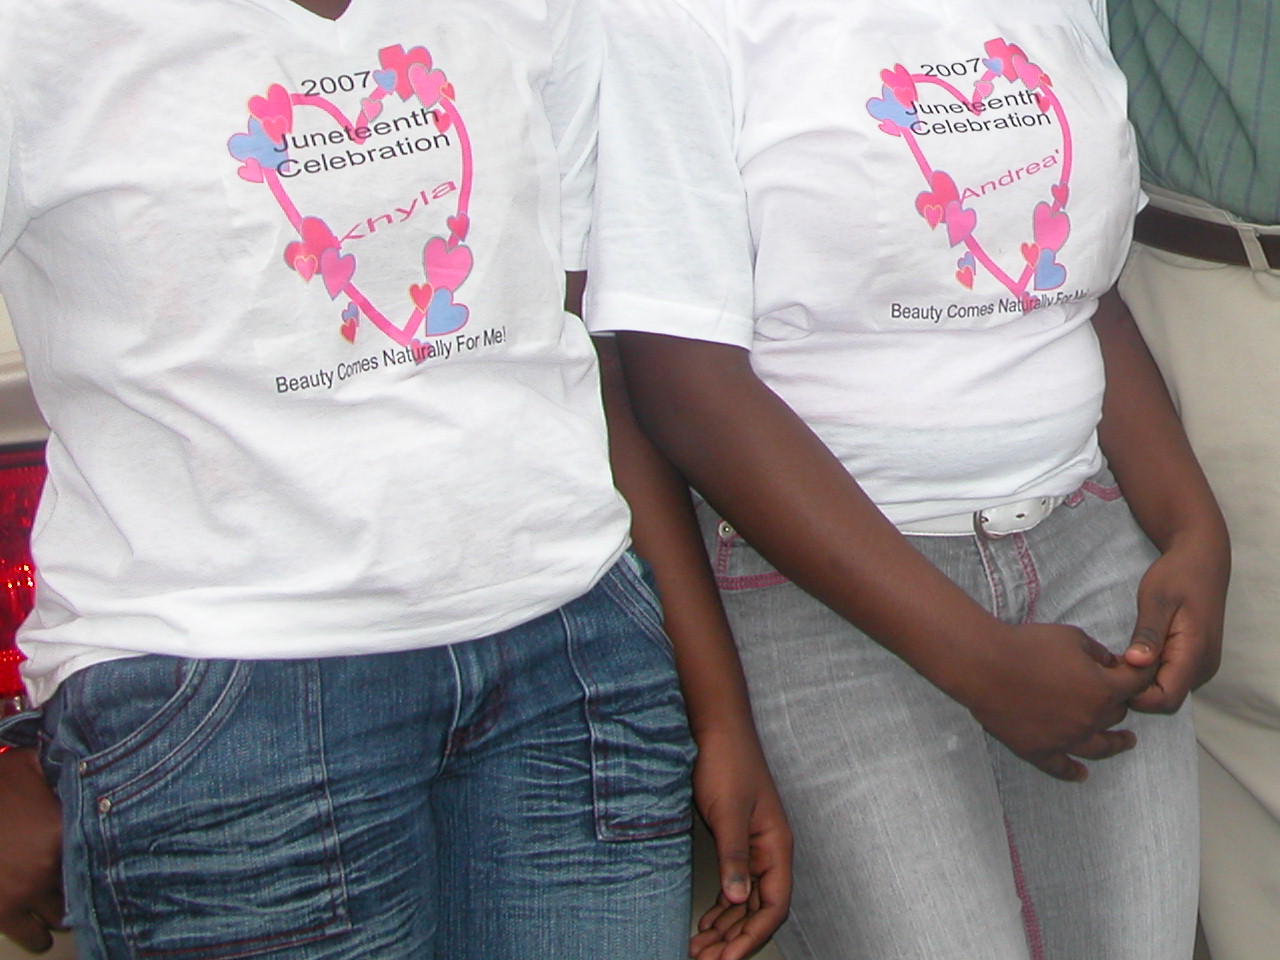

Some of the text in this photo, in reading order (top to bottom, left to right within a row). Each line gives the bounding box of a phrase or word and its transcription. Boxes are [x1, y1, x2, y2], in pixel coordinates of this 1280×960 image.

[920, 57, 981, 78] 2007
[301, 70, 372, 97] 2007
[904, 88, 1041, 117] Juneteenth
[273, 107, 440, 154] Juneteenth
[908, 111, 1052, 137] Celebration
[276, 132, 451, 179] Celebration
[891, 303, 942, 323] Beauty
[947, 302, 994, 318] Comes
[999, 294, 1054, 313] Naturally
[275, 326, 507, 393] Beauty Comes Naturally For Me!
